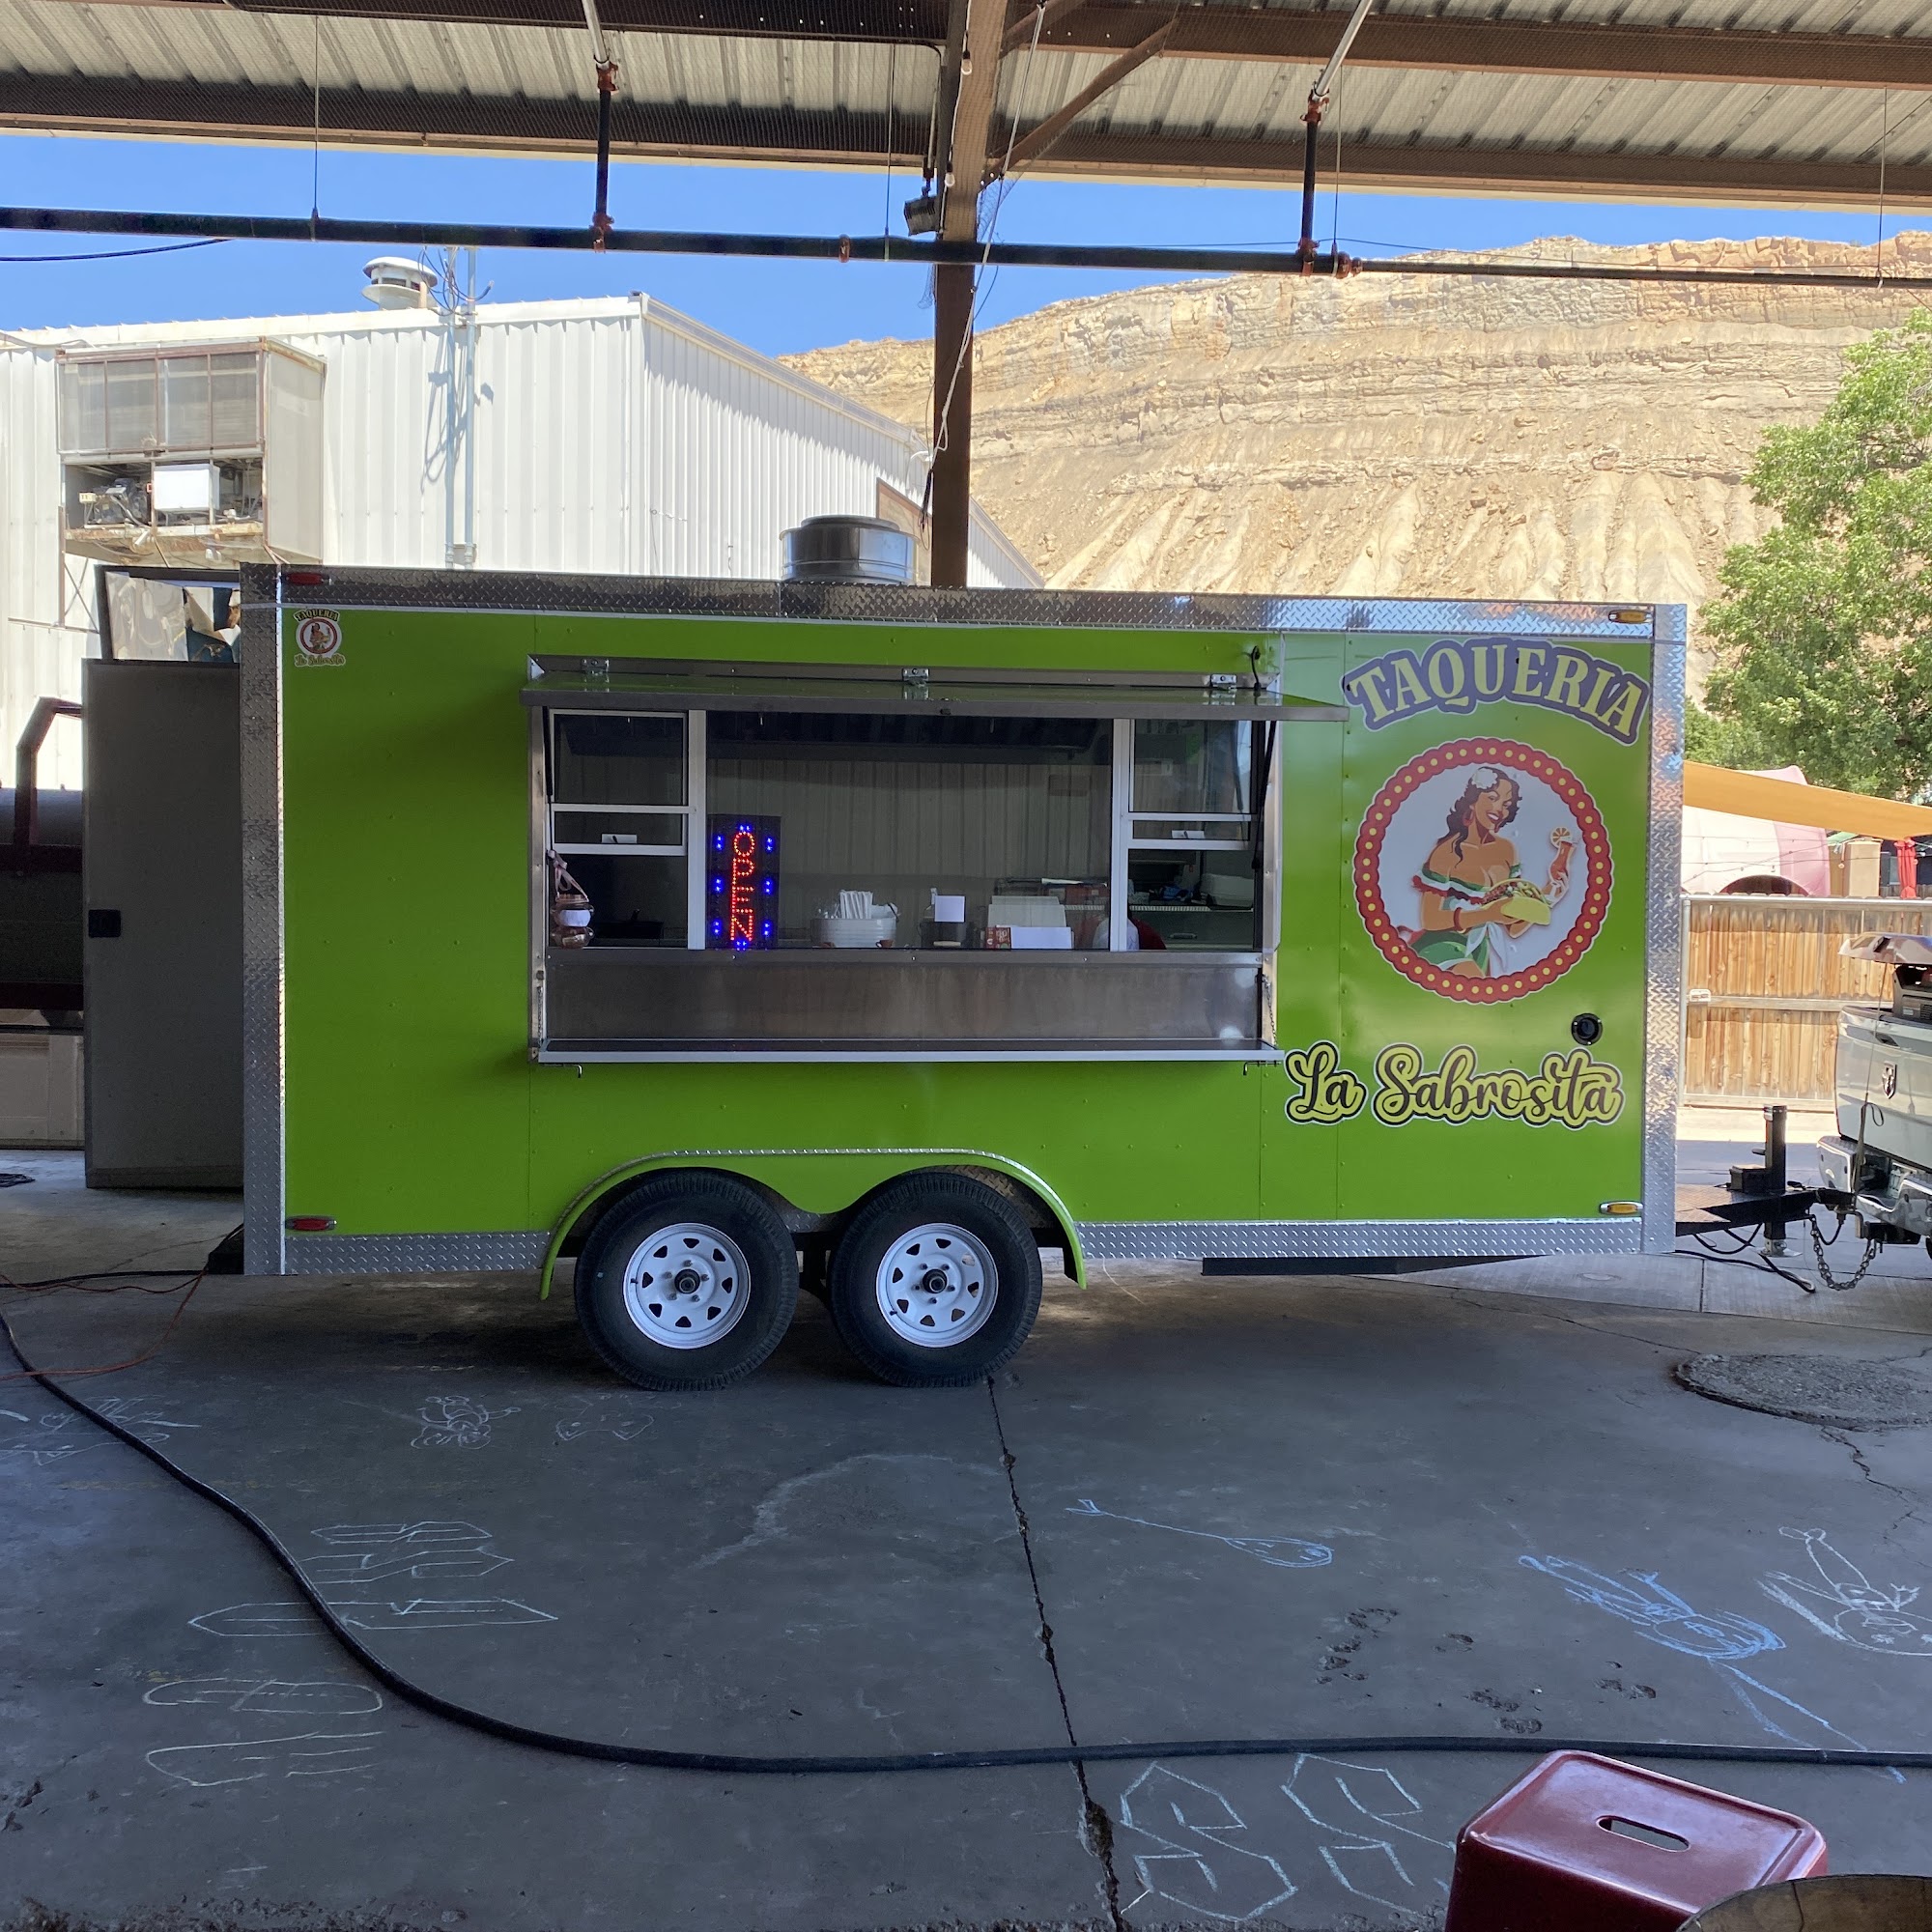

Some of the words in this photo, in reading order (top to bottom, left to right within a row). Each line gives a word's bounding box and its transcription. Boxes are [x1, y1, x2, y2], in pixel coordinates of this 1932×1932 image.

[295, 609, 339, 621] TAQUERIA
[1347, 641, 1645, 739] TAQUERIA
[731, 831, 754, 941] OPEN
[1288, 1043, 1364, 1122] La
[1376, 1045, 1622, 1126] Sabrosita
